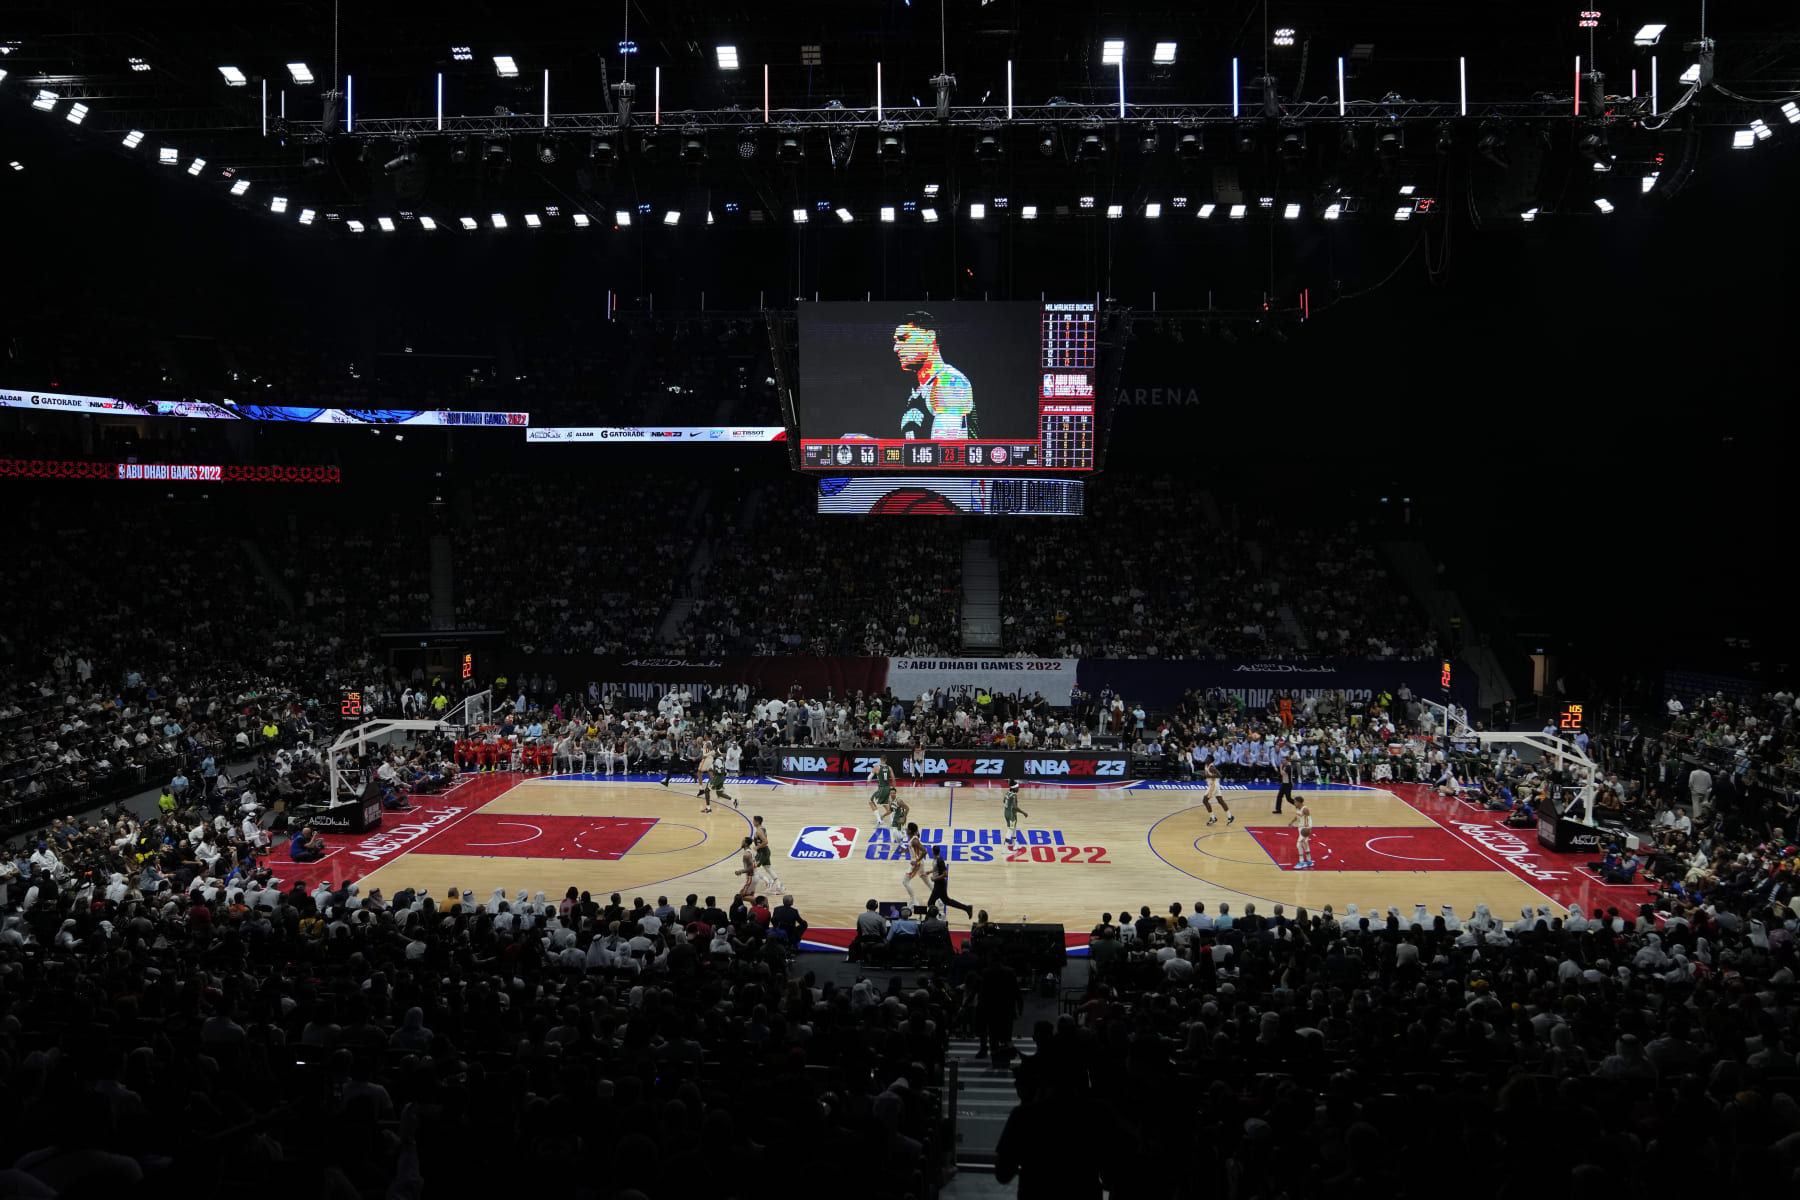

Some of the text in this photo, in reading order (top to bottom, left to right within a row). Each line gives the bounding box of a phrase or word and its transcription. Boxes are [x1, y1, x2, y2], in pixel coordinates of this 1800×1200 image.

[41, 397, 82, 406] GATORADE
[1117, 388, 1200, 406] ARENA
[860, 446, 875, 463] 53
[912, 446, 932, 463] 1:05
[944, 448, 955, 461] 23
[968, 446, 983, 463] 59
[126, 464, 221, 480] ABU DHABI GAMES 2022
[910, 661, 1062, 671] ABU DHABI GAMES 2022
[951, 684, 974, 694] VISIT
[341, 700, 360, 714] 22
[1561, 713, 1582, 728] 22
[356, 833, 392, 846] VISIT
[1496, 832, 1528, 846] VISIT
[797, 850, 827, 858] NBA
[1006, 846, 1112, 864] 2022
